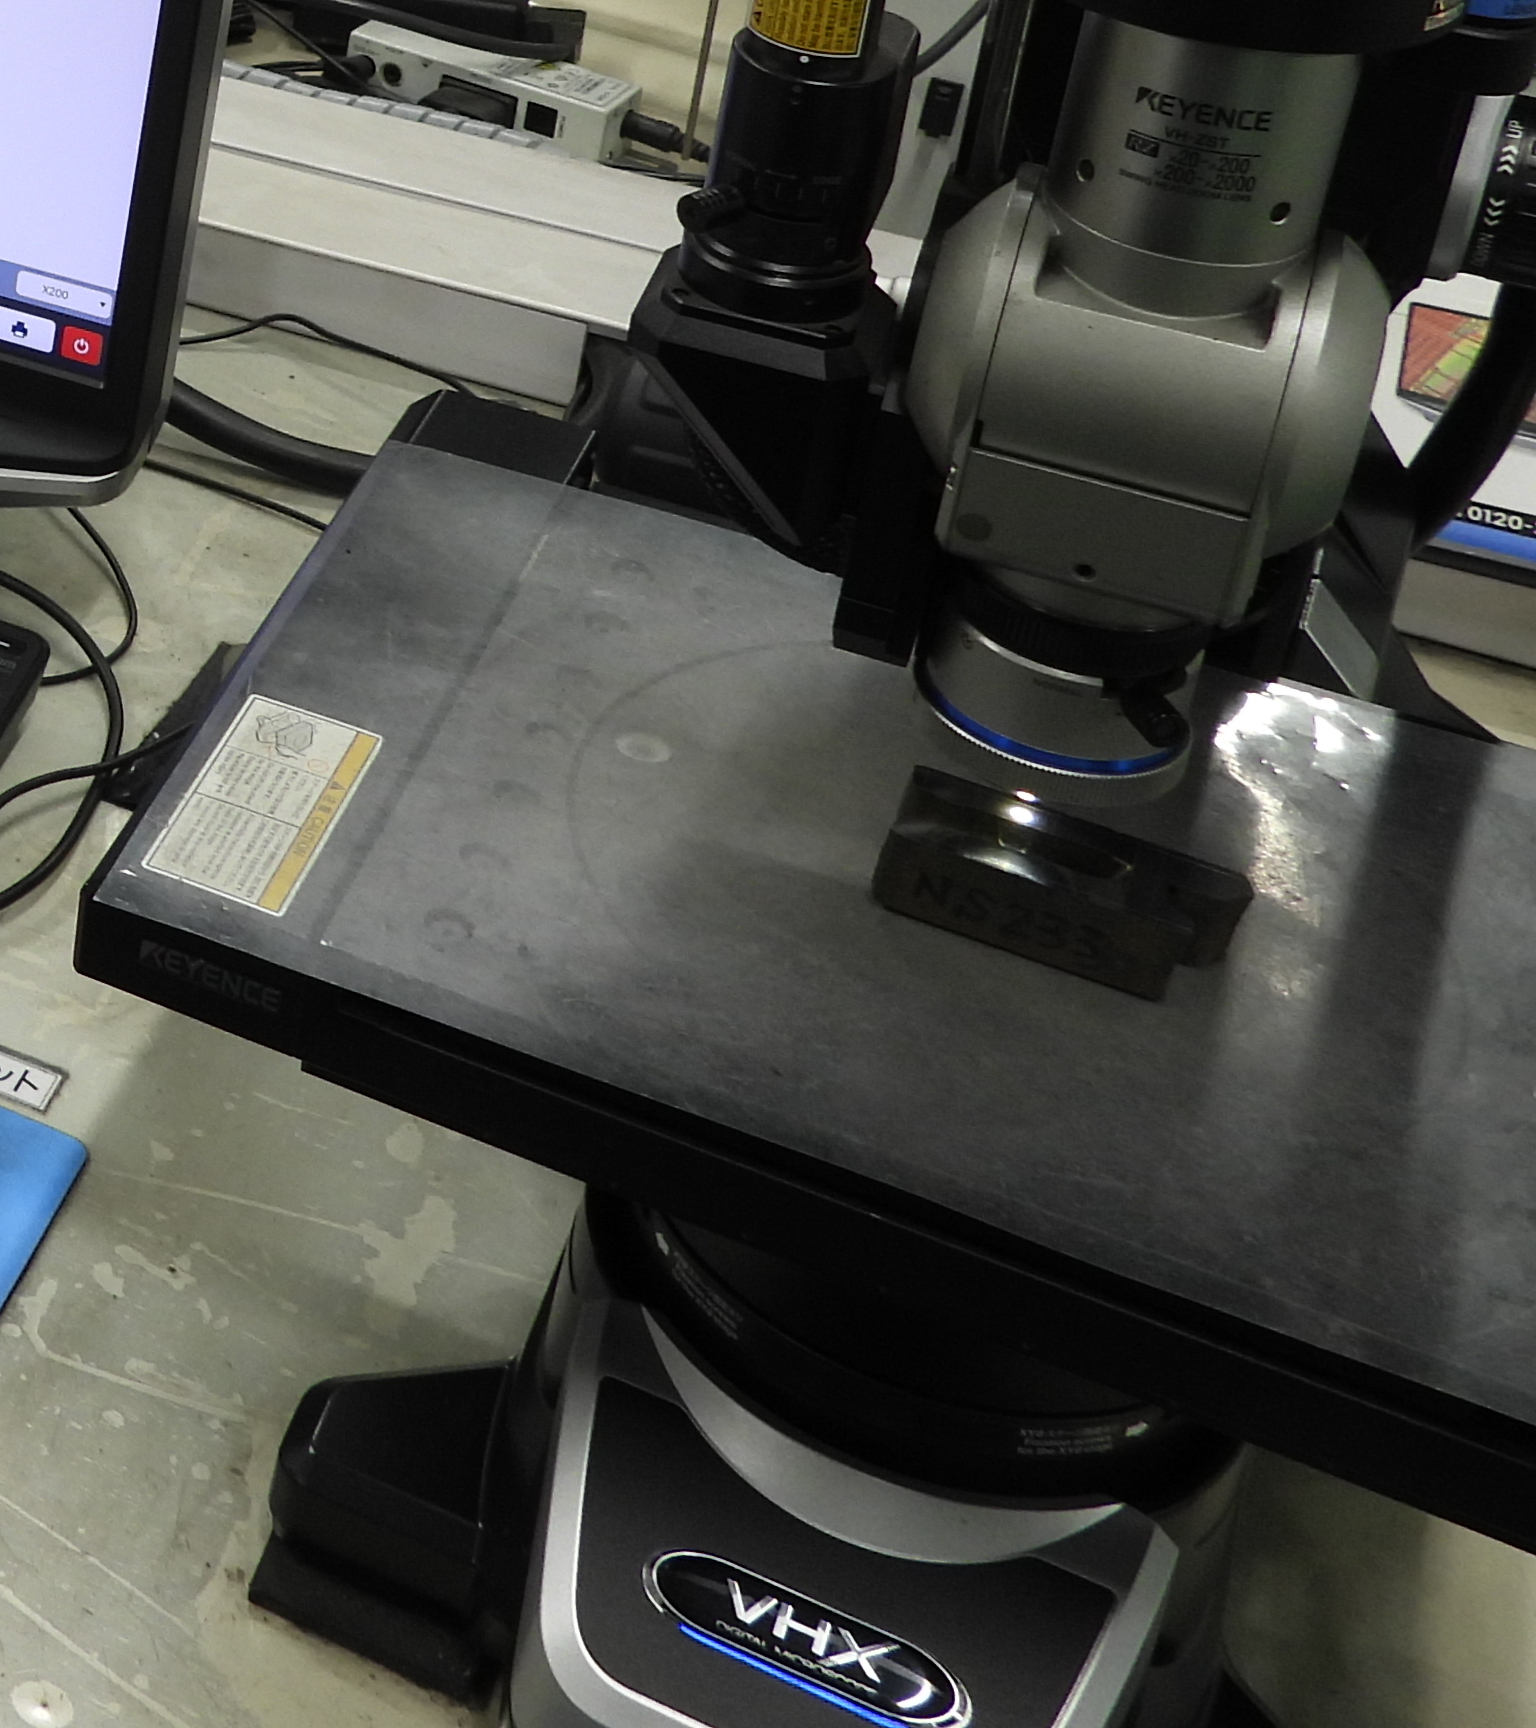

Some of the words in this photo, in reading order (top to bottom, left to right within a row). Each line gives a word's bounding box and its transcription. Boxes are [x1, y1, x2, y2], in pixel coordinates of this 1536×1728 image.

[1135, 86, 1274, 132] KEYENCE
[1506, 118, 1525, 139] UP
[1467, 507, 1536, 536] 0120-
[139, 940, 283, 1013] KEYENCE
[726, 1577, 902, 1684] VHX
